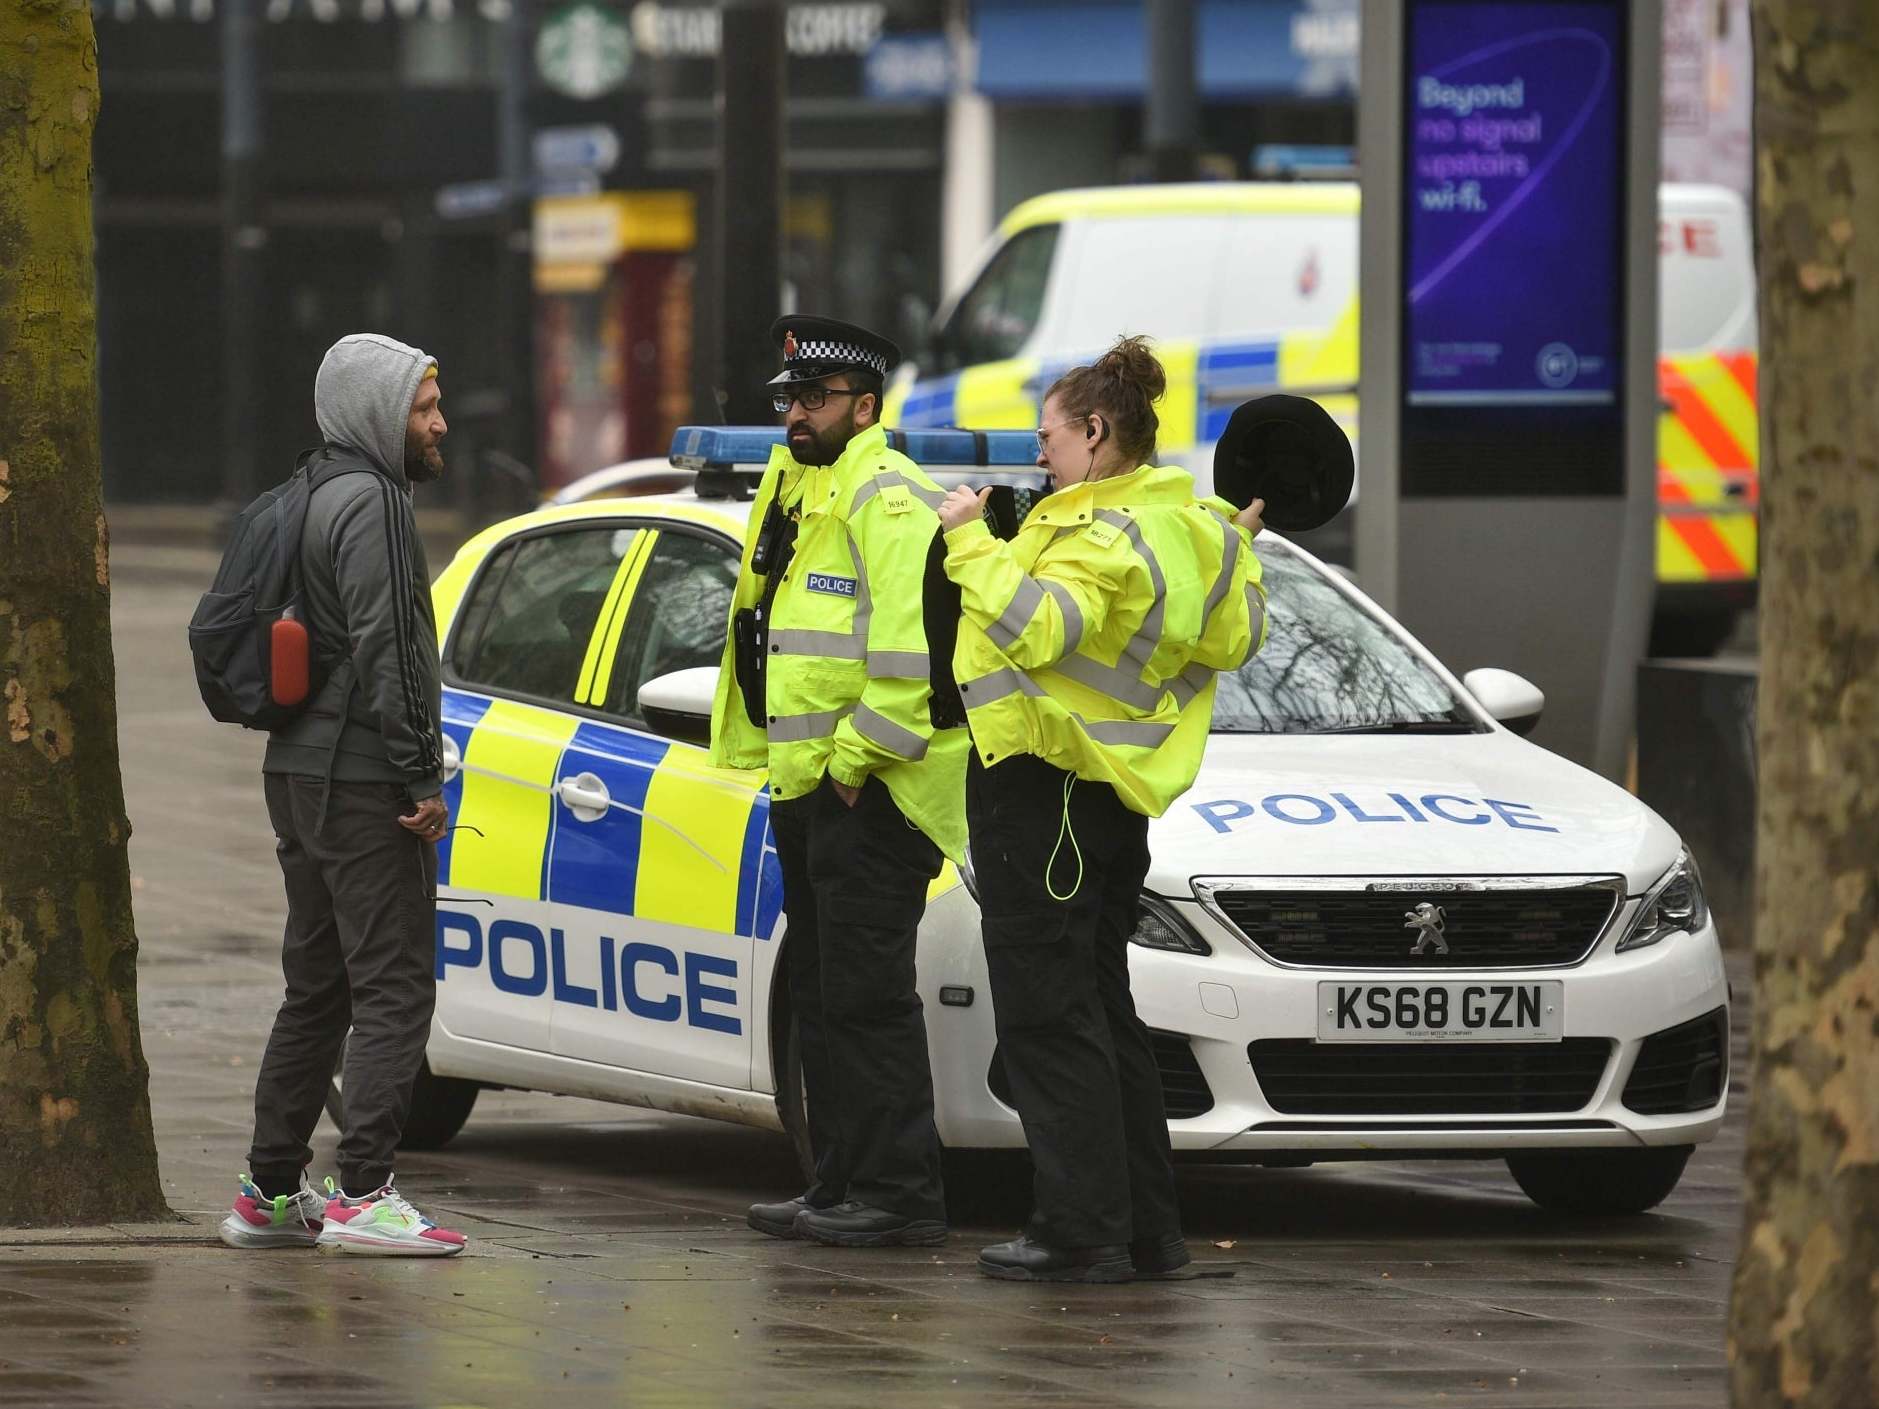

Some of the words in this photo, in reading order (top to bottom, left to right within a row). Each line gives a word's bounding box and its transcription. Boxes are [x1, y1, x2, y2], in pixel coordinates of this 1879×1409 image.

[1418, 76, 1524, 117] Beyond
[1418, 119, 1456, 142] no
[1461, 111, 1542, 150] signal
[1418, 150, 1529, 180] upstairs
[888, 500, 908, 508] 16947
[810, 576, 853, 594] POLICE
[1190, 792, 1561, 834] POLICE
[435, 909, 743, 1036] POLICE
[1337, 987, 1449, 1029] KS68
[1462, 986, 1541, 1028] GZN
